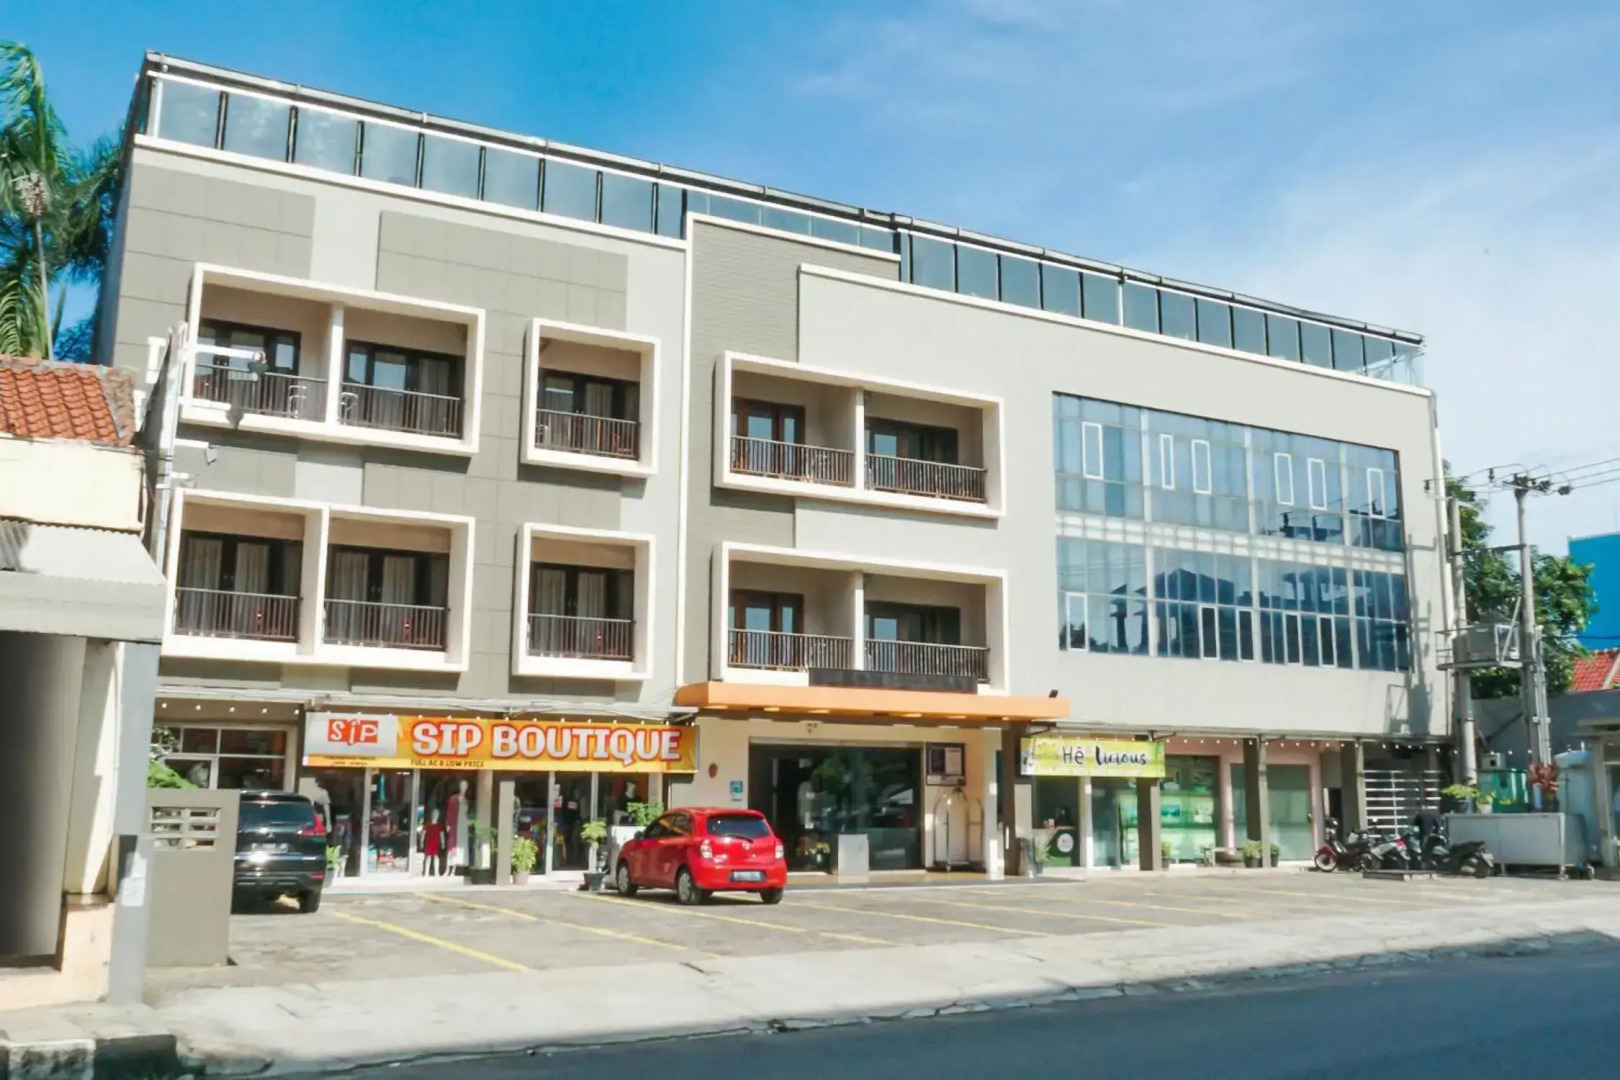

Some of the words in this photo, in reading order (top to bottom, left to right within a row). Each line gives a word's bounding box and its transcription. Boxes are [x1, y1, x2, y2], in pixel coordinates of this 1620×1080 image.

[411, 720, 483, 757] SIP
[491, 724, 684, 766] BOUTIQUE
[411, 759, 426, 767] FULL
[428, 759, 439, 767] AC
[446, 760, 462, 768] LOW
